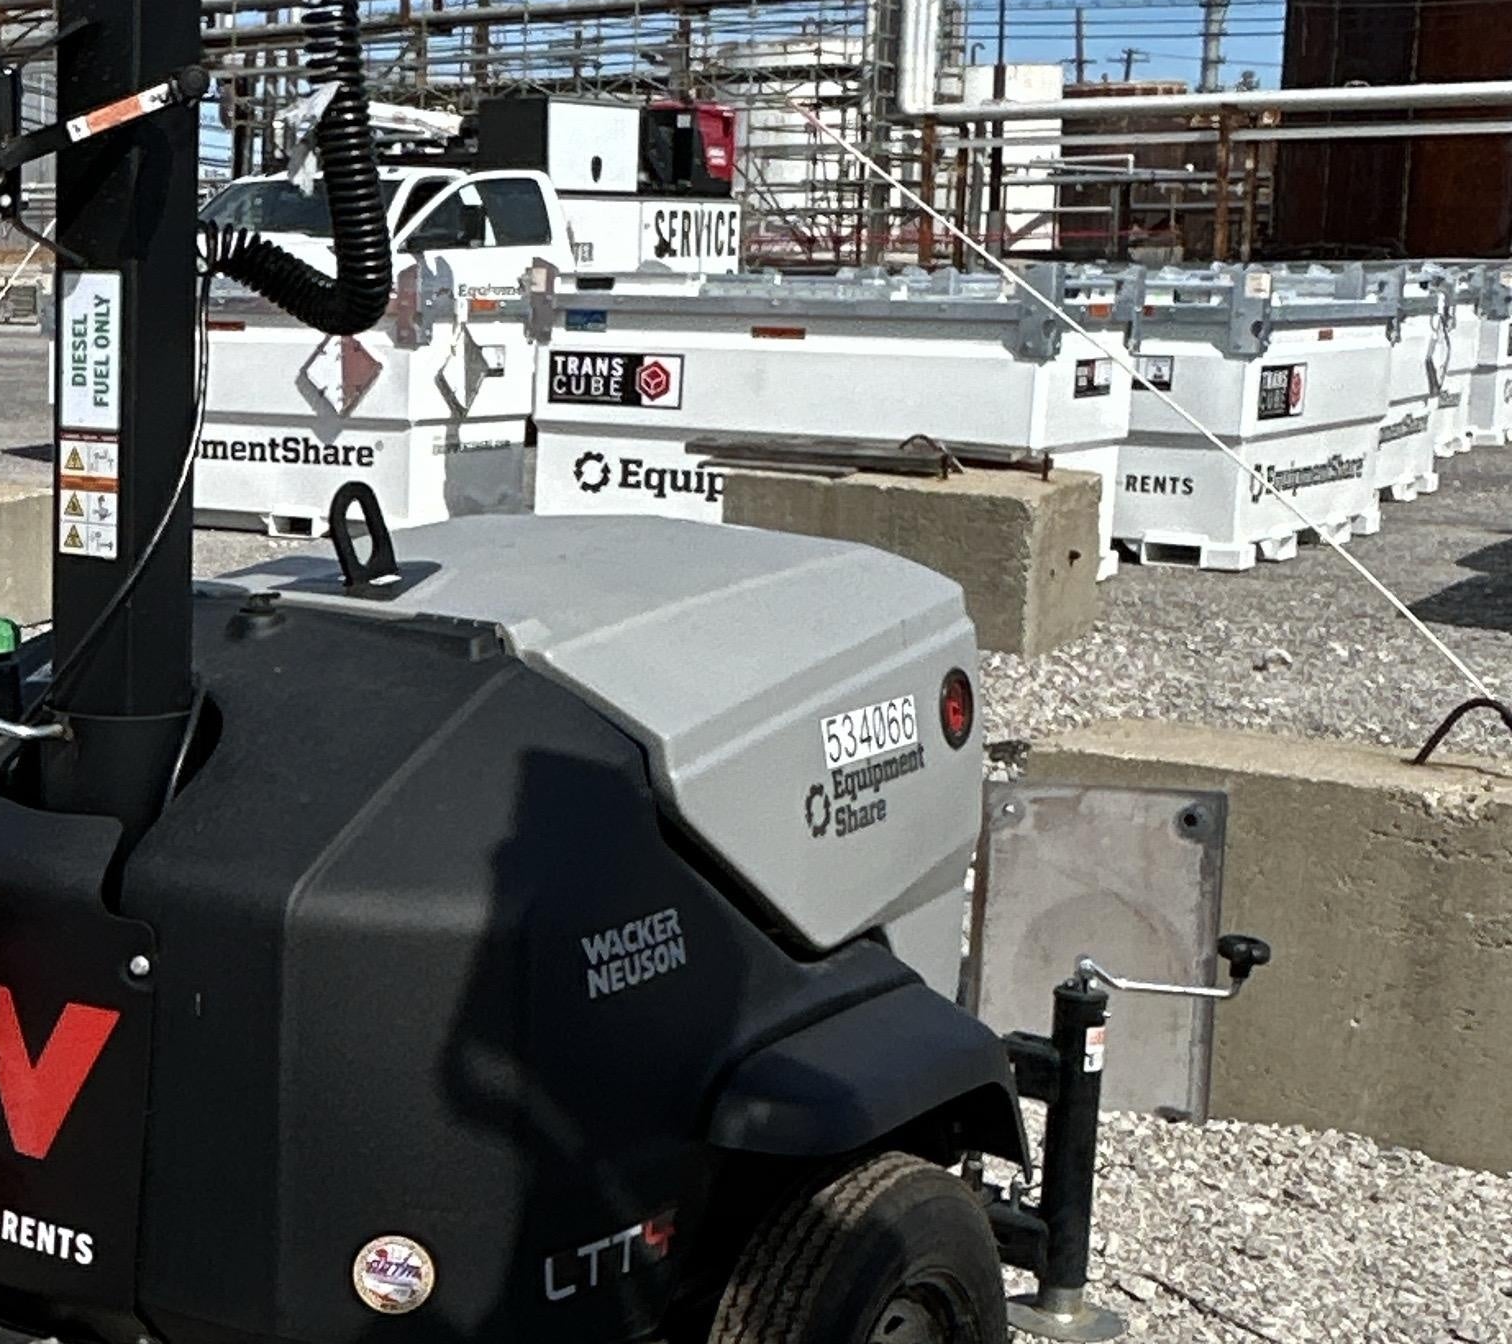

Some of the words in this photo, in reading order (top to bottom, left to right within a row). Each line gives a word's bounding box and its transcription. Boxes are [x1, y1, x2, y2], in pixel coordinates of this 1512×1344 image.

[654, 209, 738, 260] SERVICE
[94, 293, 111, 348] ONLY
[71, 312, 89, 388] DIESEL
[553, 354, 624, 377] TRANS
[93, 356, 110, 408] FUEL
[552, 373, 623, 397] CUBE
[193, 436, 374, 467] mentShare
[825, 697, 915, 763] 534066
[831, 742, 925, 801] Equipment
[834, 798, 887, 837] Share
[581, 908, 683, 965] WACKER
[587, 936, 687, 999] NEUSON
